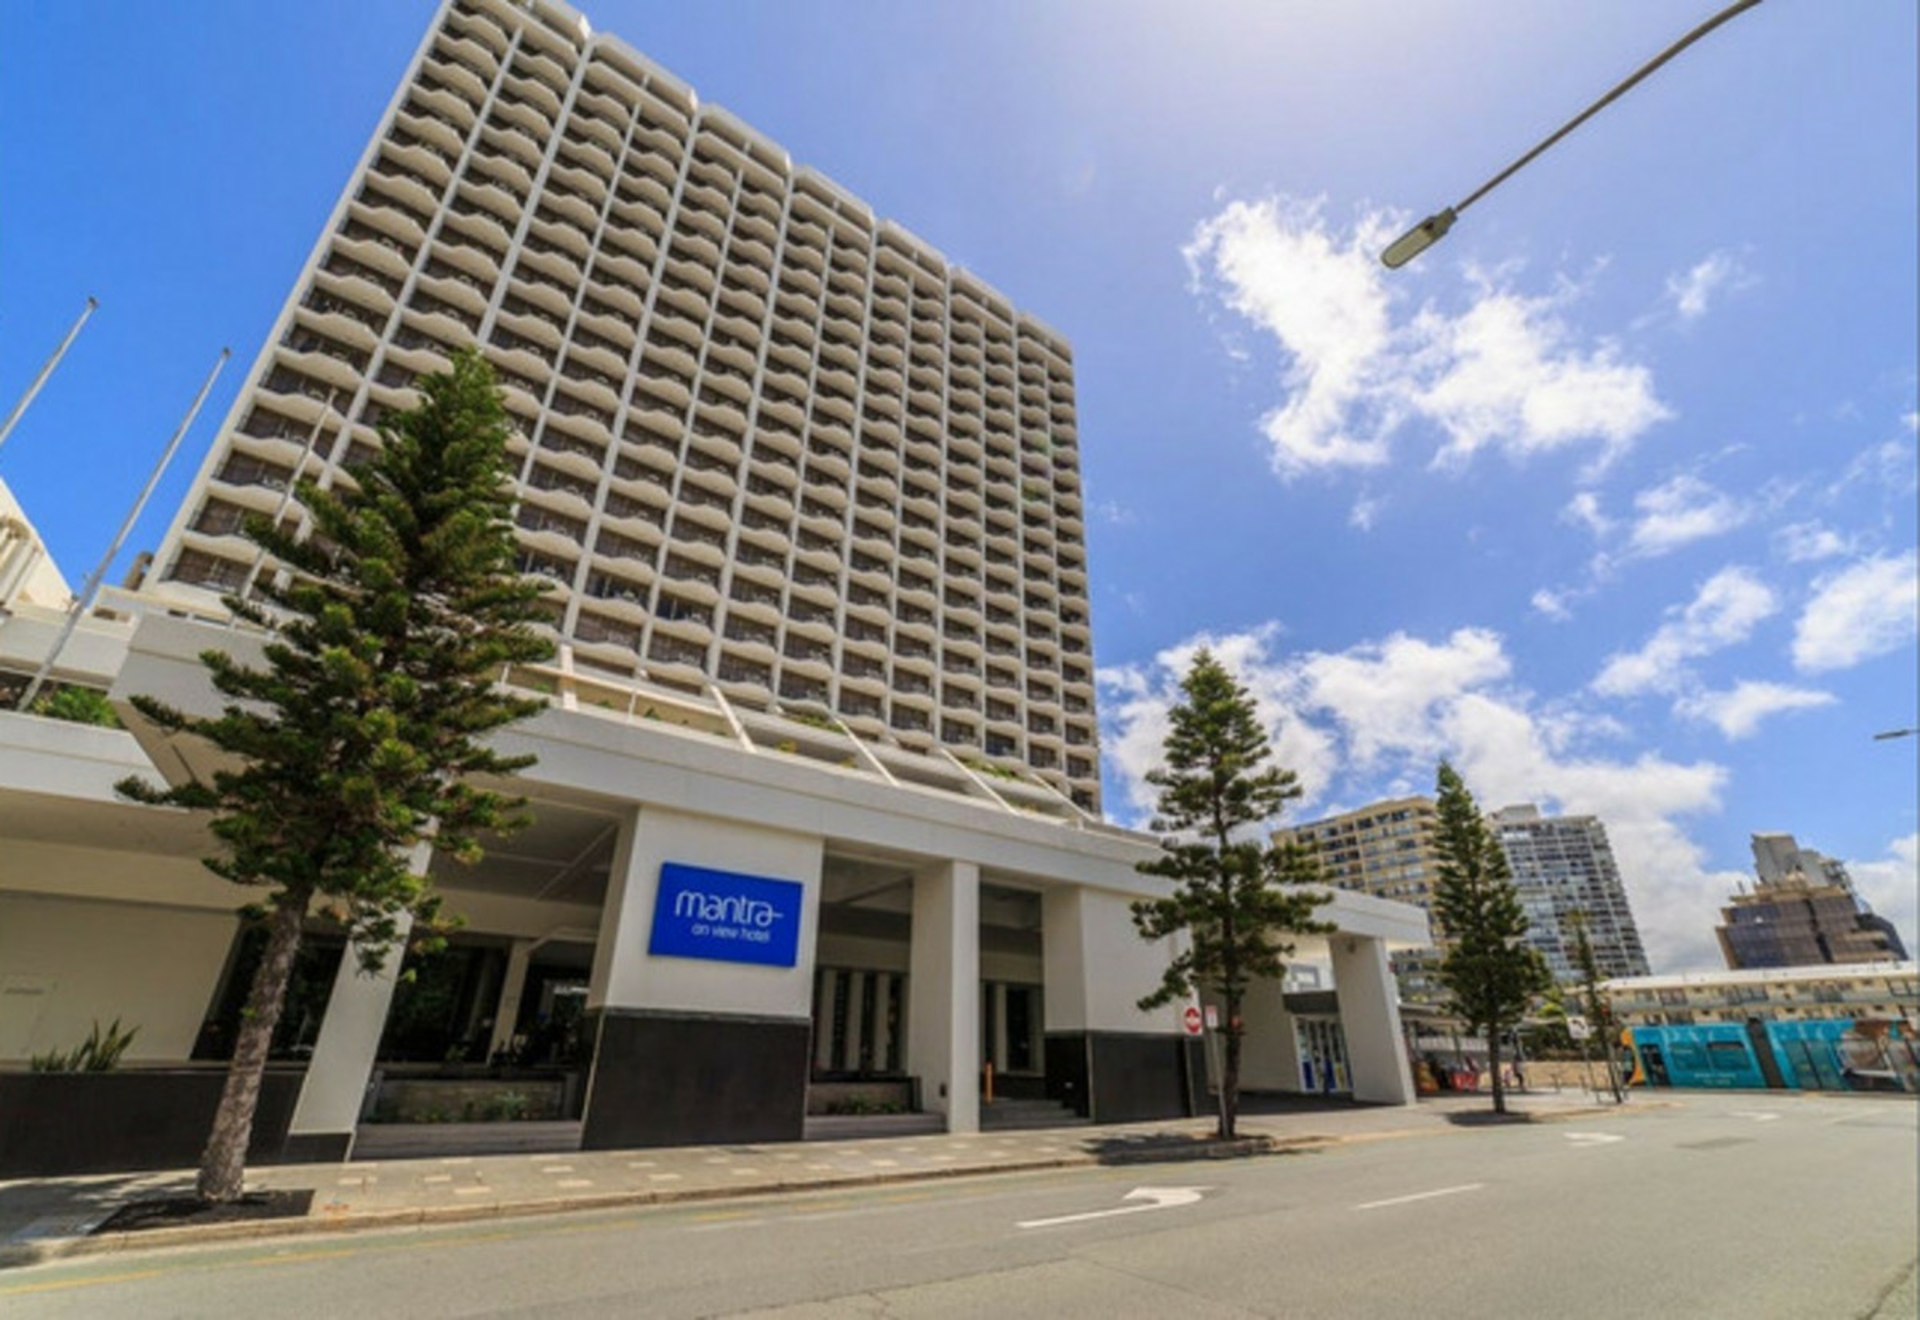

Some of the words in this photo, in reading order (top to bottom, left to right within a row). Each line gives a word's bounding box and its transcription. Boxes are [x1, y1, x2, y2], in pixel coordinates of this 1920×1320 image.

[675, 890, 783, 926] mantra
[691, 923, 710, 936] on
[712, 925, 739, 939] view
[741, 927, 770, 943] hotel
